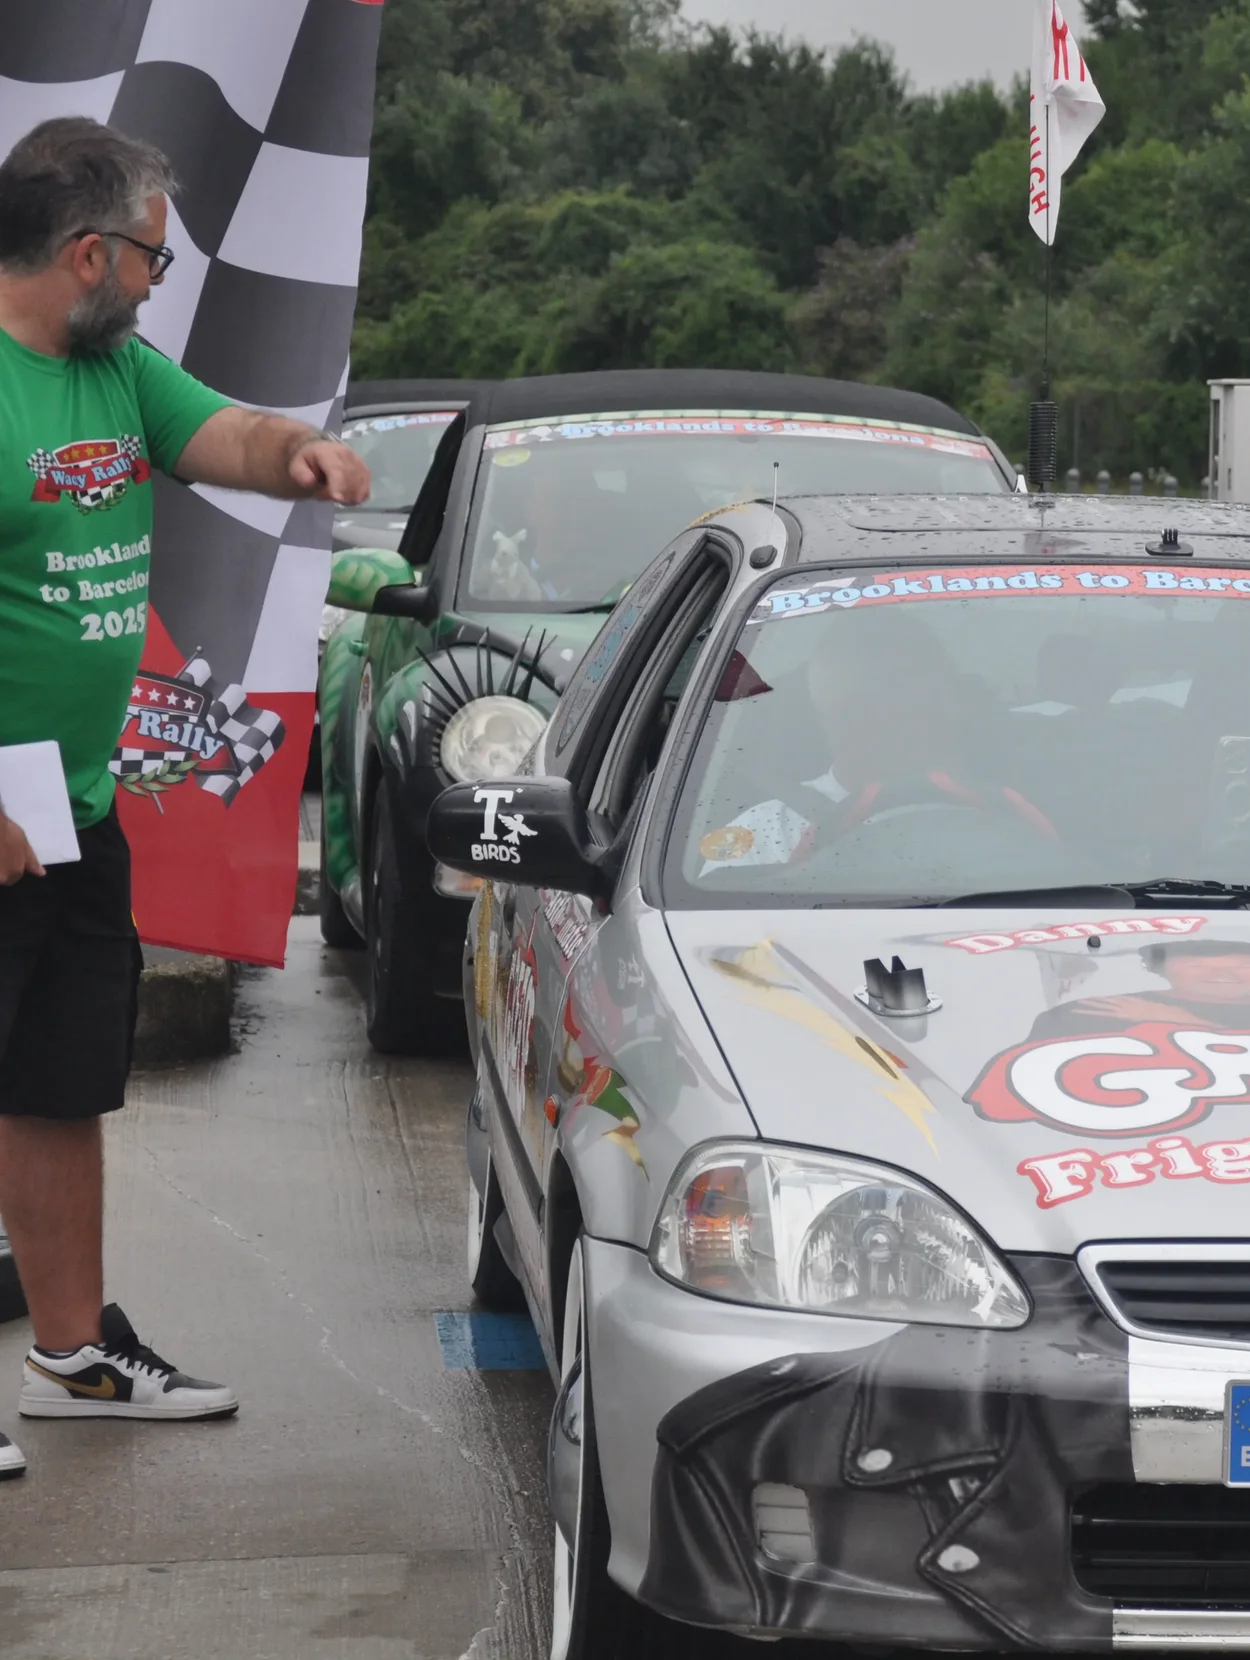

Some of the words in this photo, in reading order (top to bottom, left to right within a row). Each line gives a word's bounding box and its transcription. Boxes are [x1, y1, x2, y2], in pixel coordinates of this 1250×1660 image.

[743, 422, 775, 433] to
[39, 583, 71, 603] to
[767, 570, 1064, 614] Brooklands
[1075, 571, 1131, 589] to
[136, 707, 225, 762] Rally
[471, 844, 521, 865] BIRDS
[946, 916, 1205, 955] Danny
